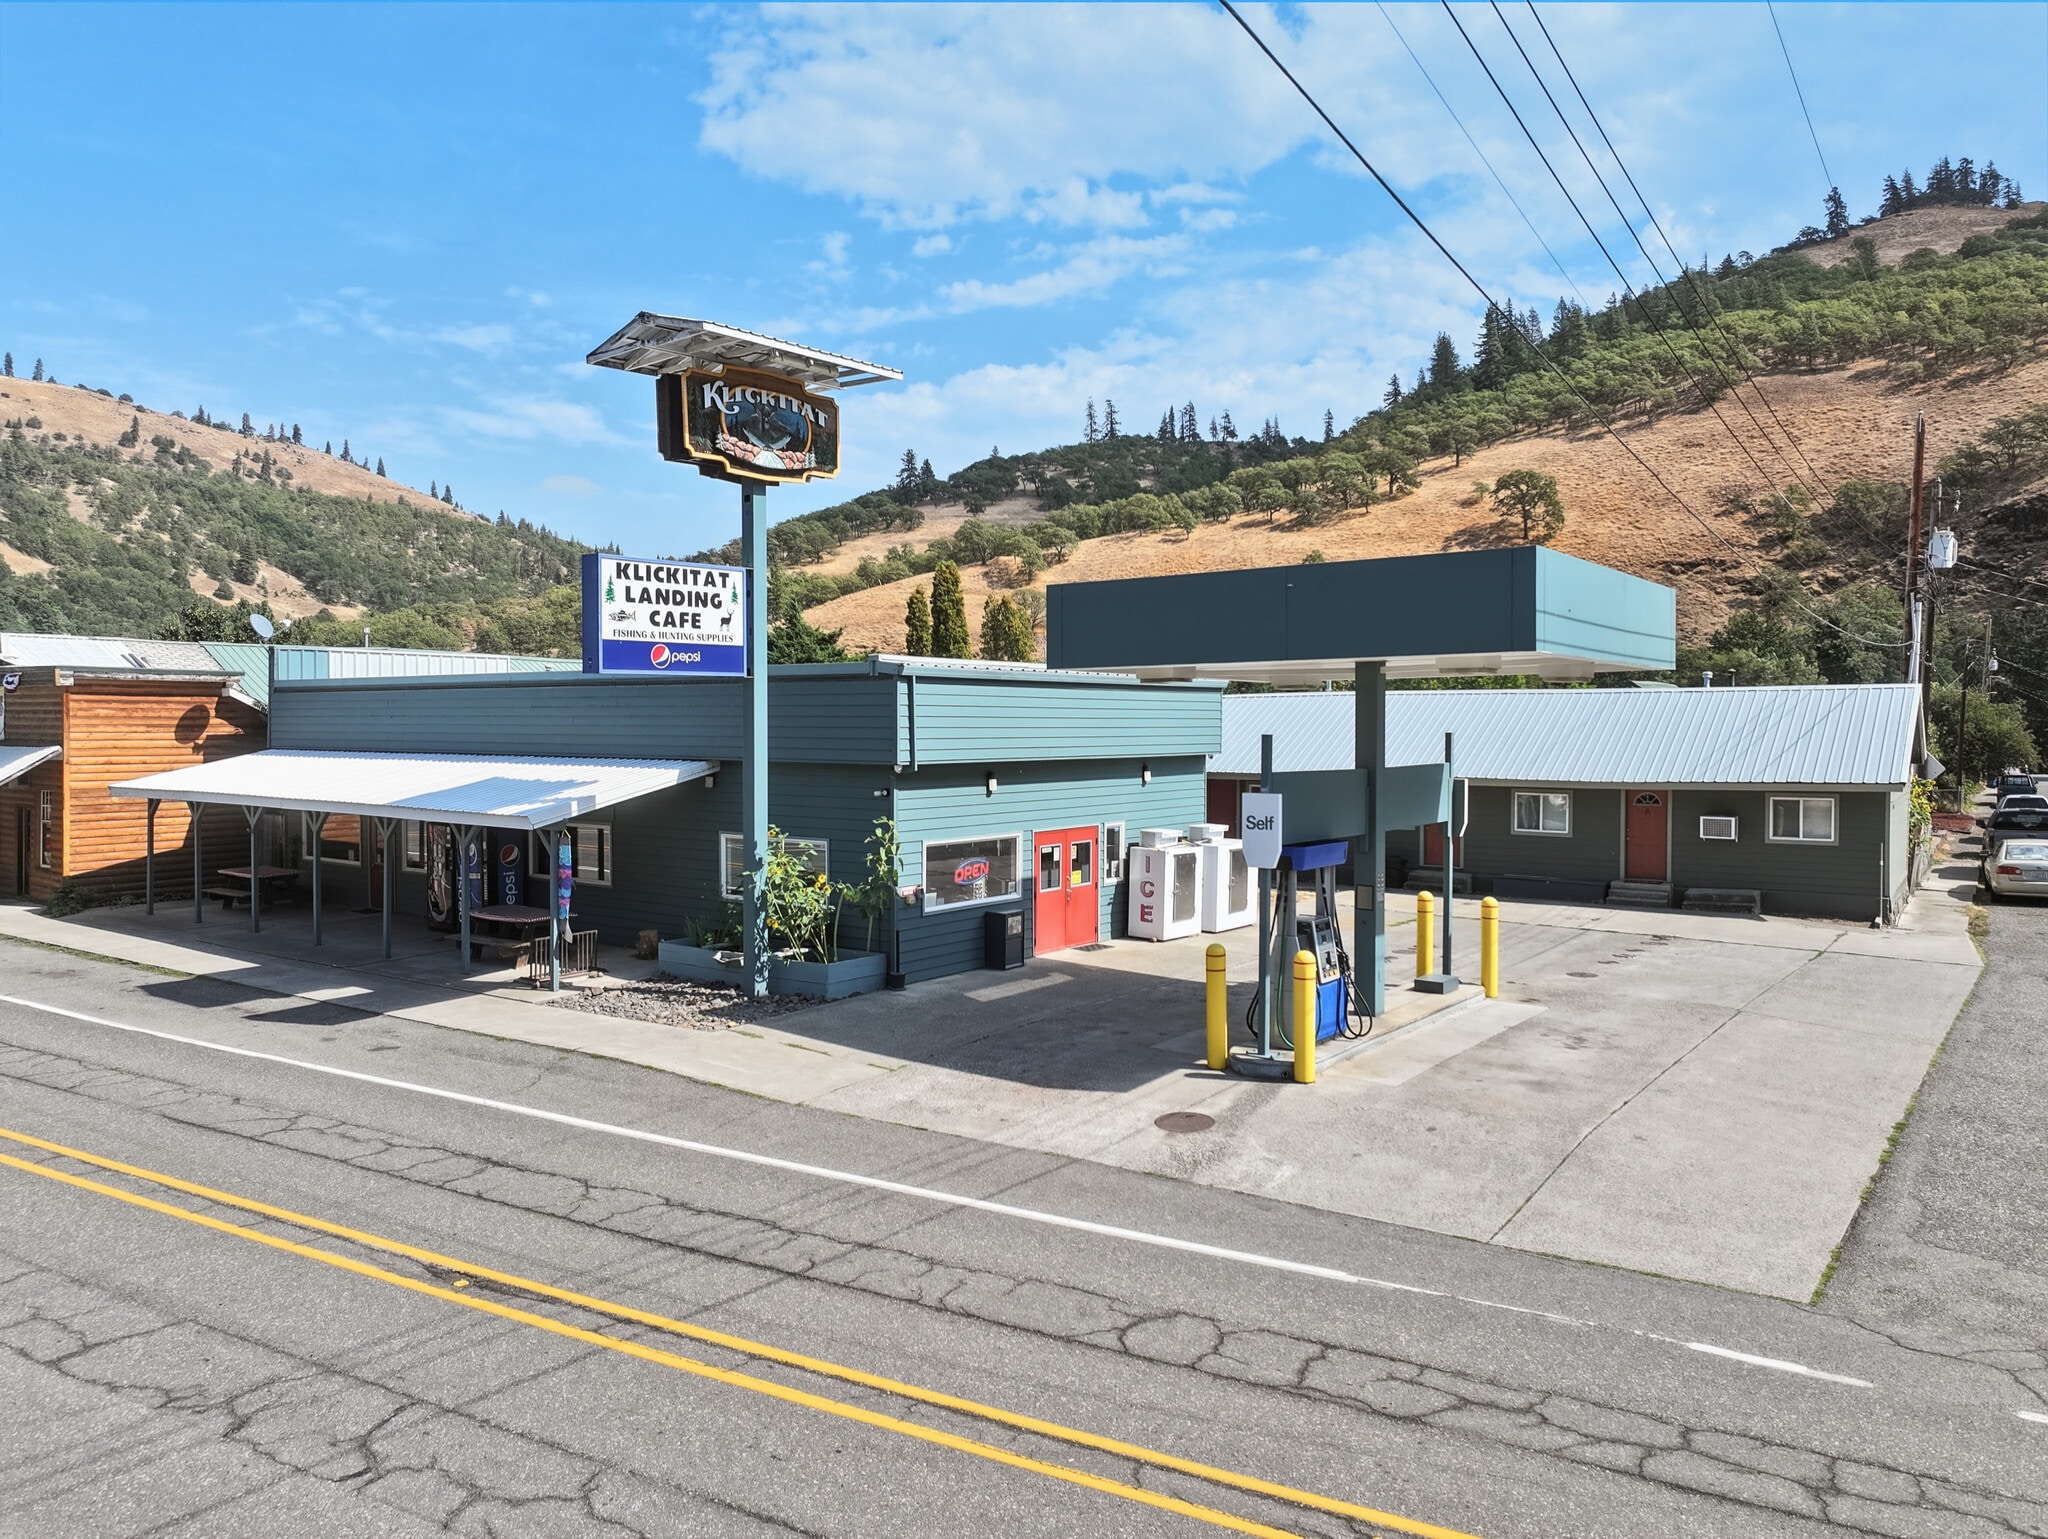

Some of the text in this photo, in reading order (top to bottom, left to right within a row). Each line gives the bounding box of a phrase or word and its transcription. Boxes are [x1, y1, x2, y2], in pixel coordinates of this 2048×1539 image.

[702, 380, 828, 427] KLICKITAT
[616, 562, 729, 588] KLICKITAT
[625, 586, 723, 609] LANDING
[649, 611, 702, 629] CAFE
[613, 629, 734, 643] FISHING & HUNTING SUPPLIES
[671, 651, 701, 663] pepsi
[1245, 815, 1275, 831] Self
[954, 861, 990, 884] OPEN
[503, 869, 518, 905] epsi
[1139, 855, 1155, 924] ICE
